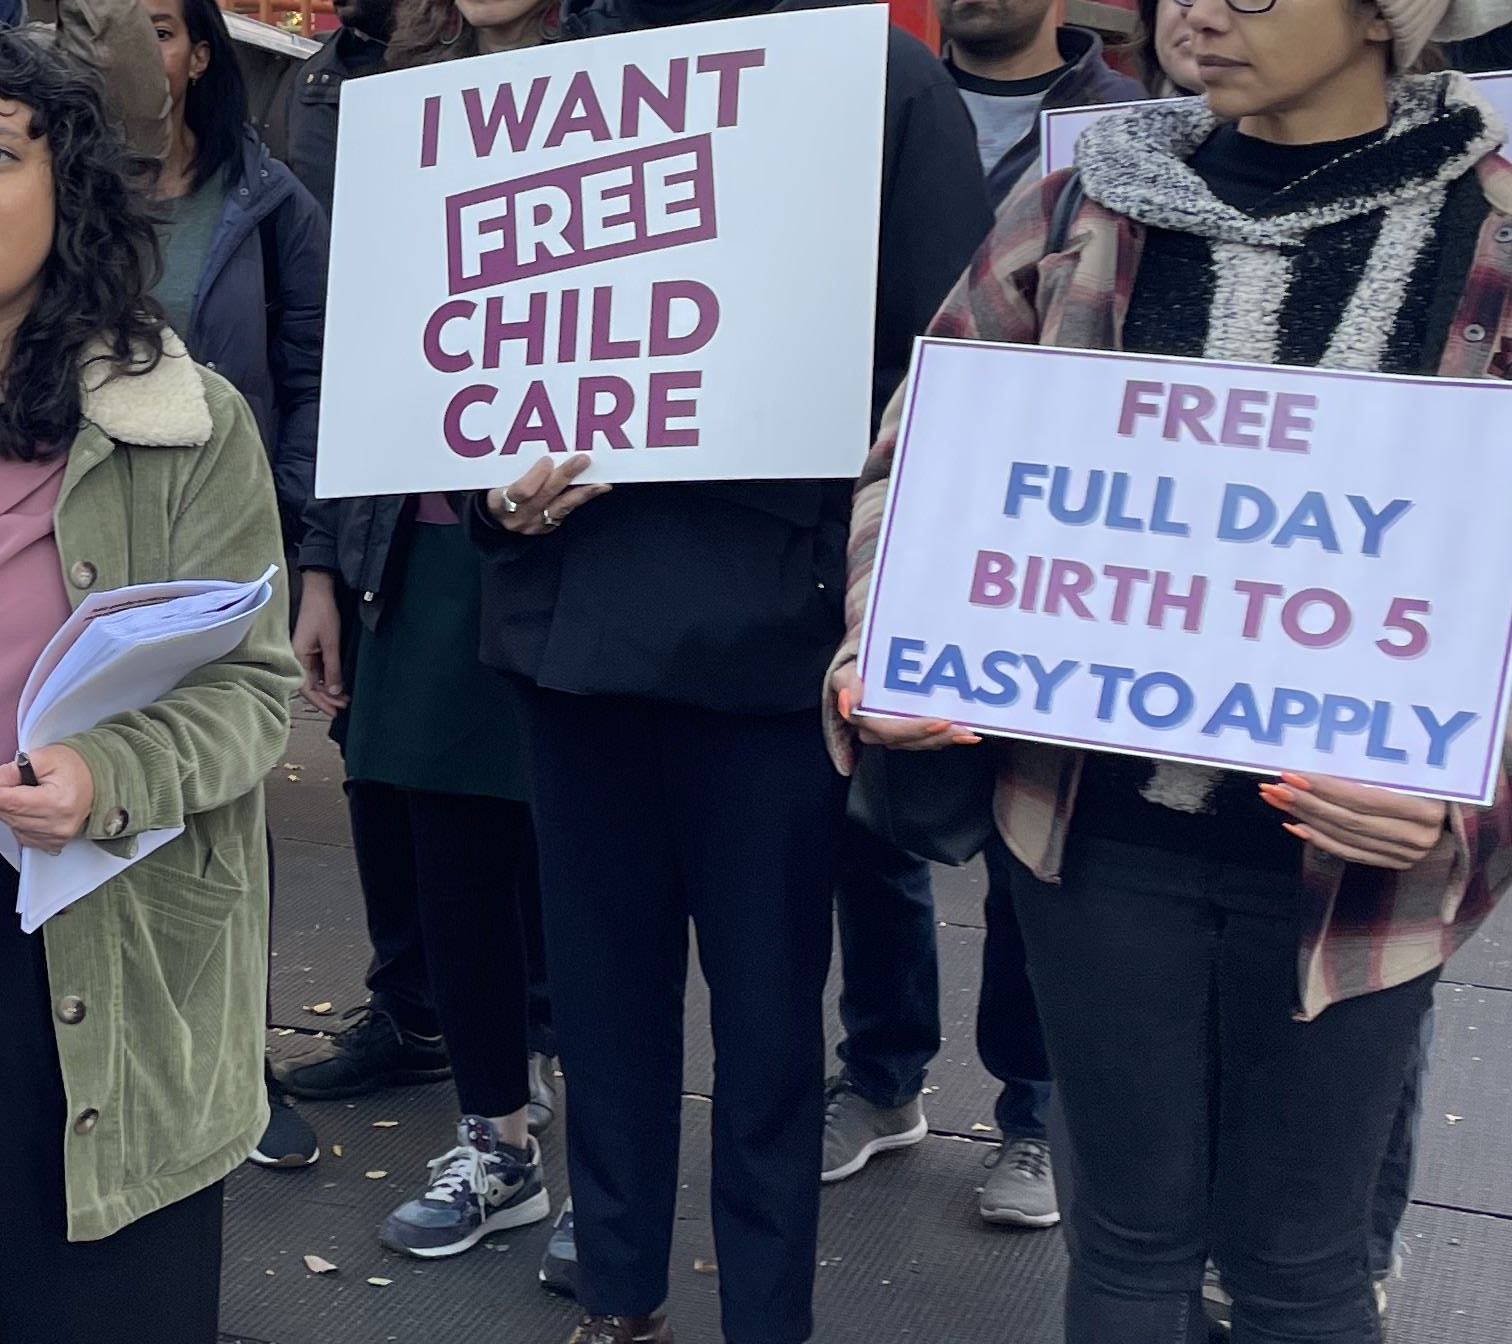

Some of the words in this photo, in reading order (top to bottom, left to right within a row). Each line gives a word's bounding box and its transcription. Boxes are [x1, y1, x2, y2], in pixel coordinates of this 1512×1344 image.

[420, 95, 441, 169] I
[461, 48, 766, 158] WANT
[459, 151, 702, 280] FREE
[423, 279, 721, 374] CHILD
[443, 370, 703, 458] CARE
[1116, 379, 1318, 454] FREE
[1003, 462, 1190, 539] FULL
[1217, 482, 1414, 558] DAY
[968, 549, 1209, 635] BIRTH
[1233, 579, 1353, 649] TO
[1374, 598, 1434, 661] 5
[884, 636, 1080, 714] EASY
[1089, 663, 1195, 729] TO
[1200, 681, 1481, 769] APPLY
